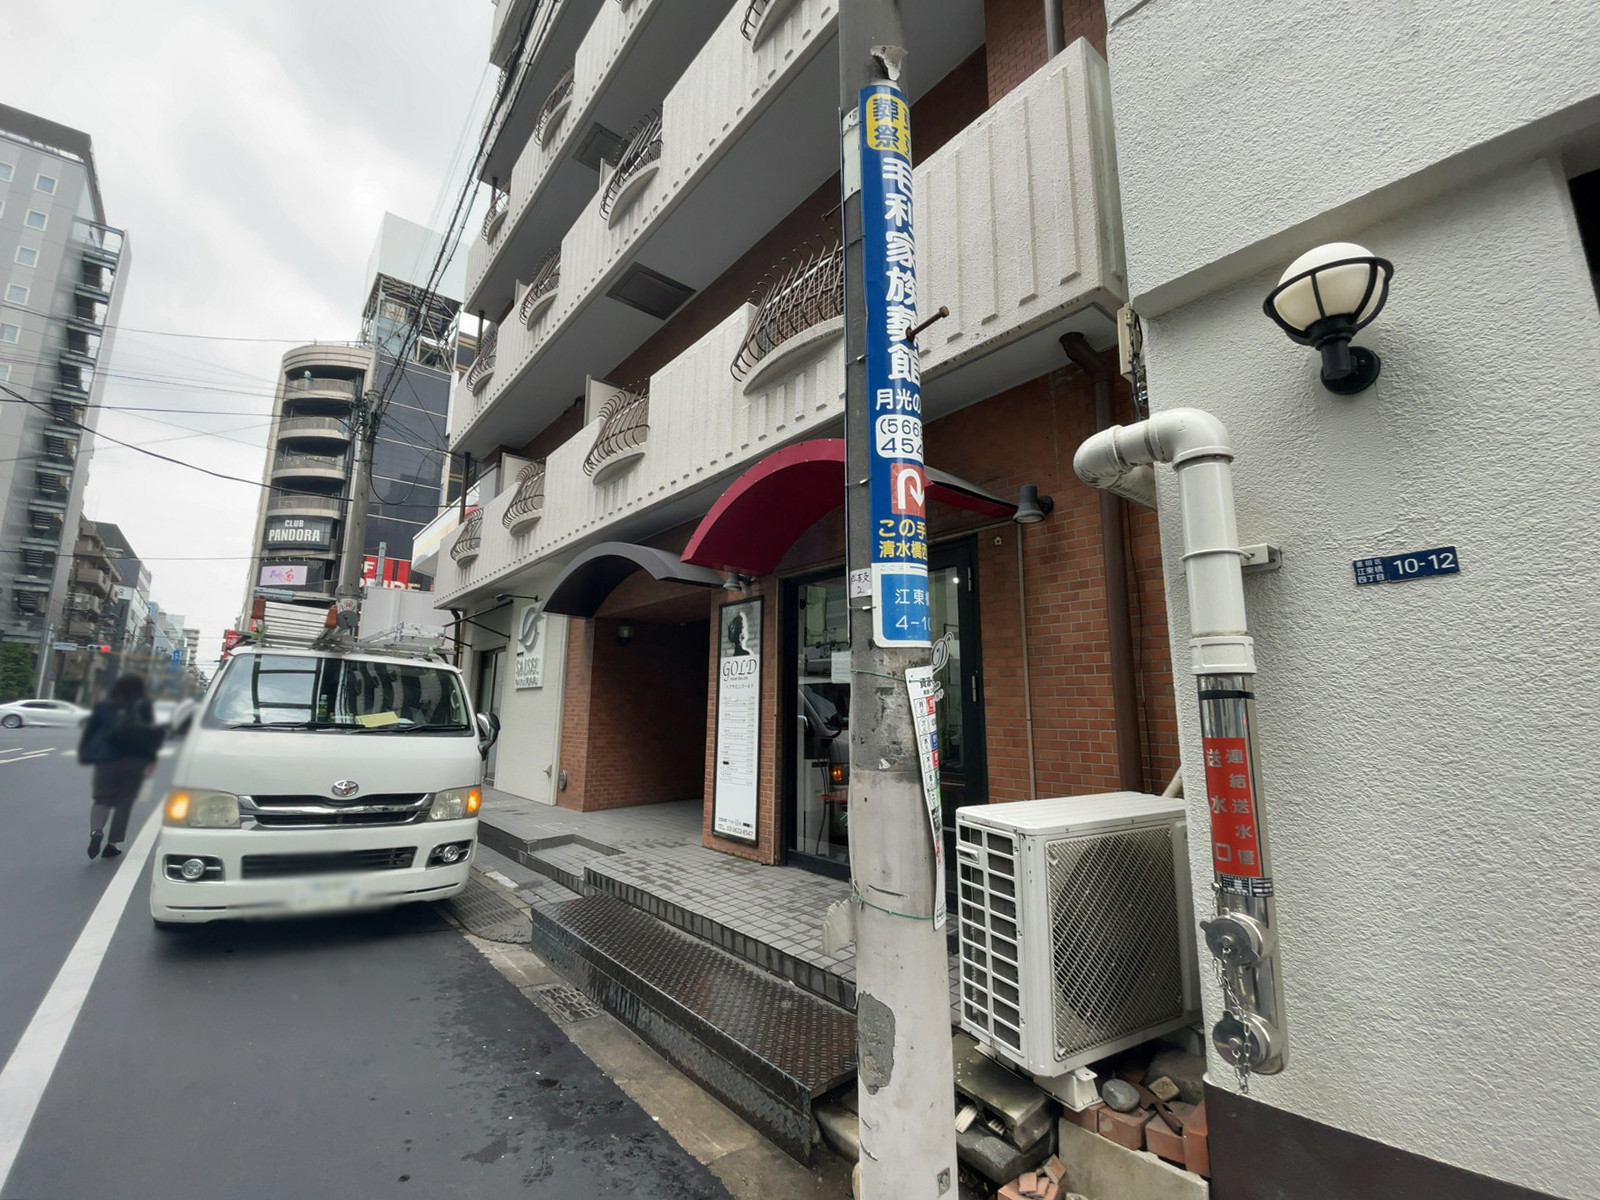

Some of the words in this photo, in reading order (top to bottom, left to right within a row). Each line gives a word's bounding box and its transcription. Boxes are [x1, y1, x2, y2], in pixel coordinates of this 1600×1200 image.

[872, 96, 900, 150] 葬祭
[880, 418, 923, 438] (566
[284, 519, 305, 528] CLUB
[268, 529, 321, 542] PANDORA
[1393, 553, 1456, 575] 10-12
[722, 658, 757, 682] GOLD
[1206, 748, 1232, 862] 送水口
